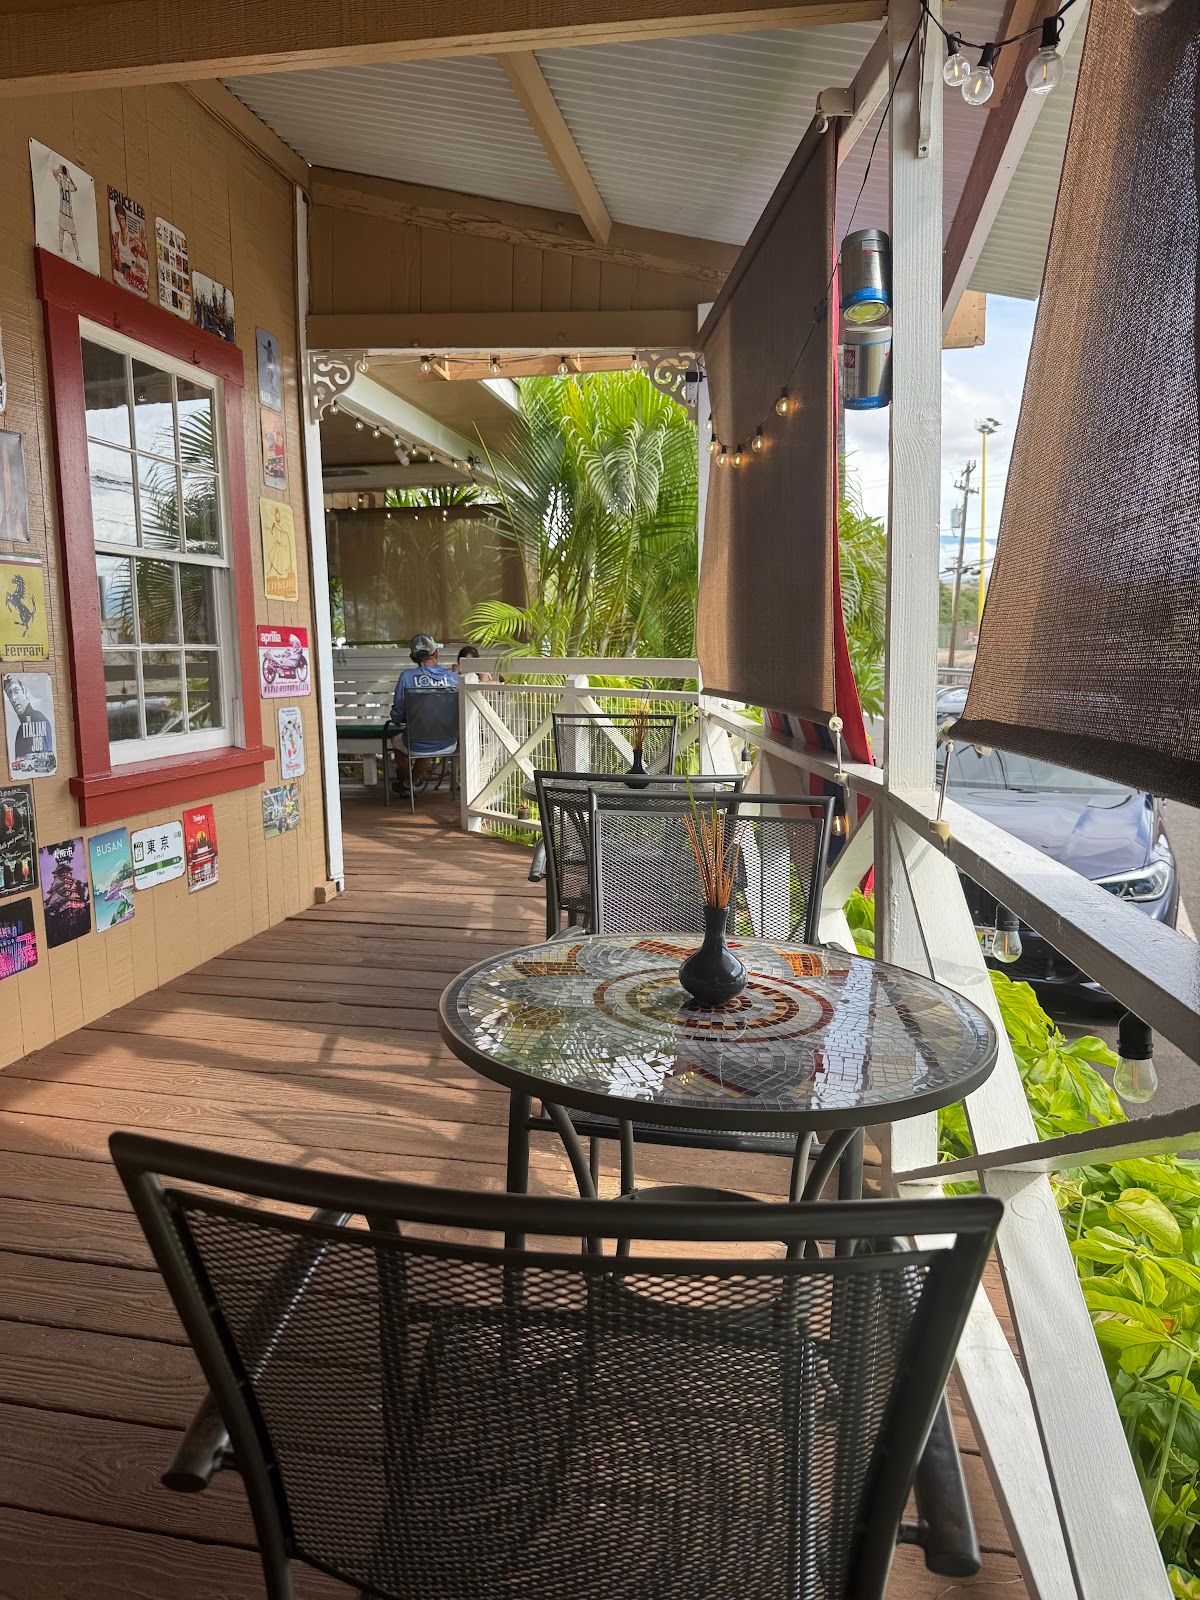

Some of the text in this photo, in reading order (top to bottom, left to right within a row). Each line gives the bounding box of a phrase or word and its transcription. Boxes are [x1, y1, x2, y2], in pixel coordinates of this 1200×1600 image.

[109, 187, 145, 220] BRUCE LEE
[260, 631, 282, 645] aprilia
[4, 644, 44, 657] Ferrari
[414, 674, 451, 688] LOCAL
[22, 720, 47, 739] ITALIAN
[31, 737, 44, 752] JOB
[96, 838, 123, 857] BUSAN
[146, 835, 170, 855] 東京
